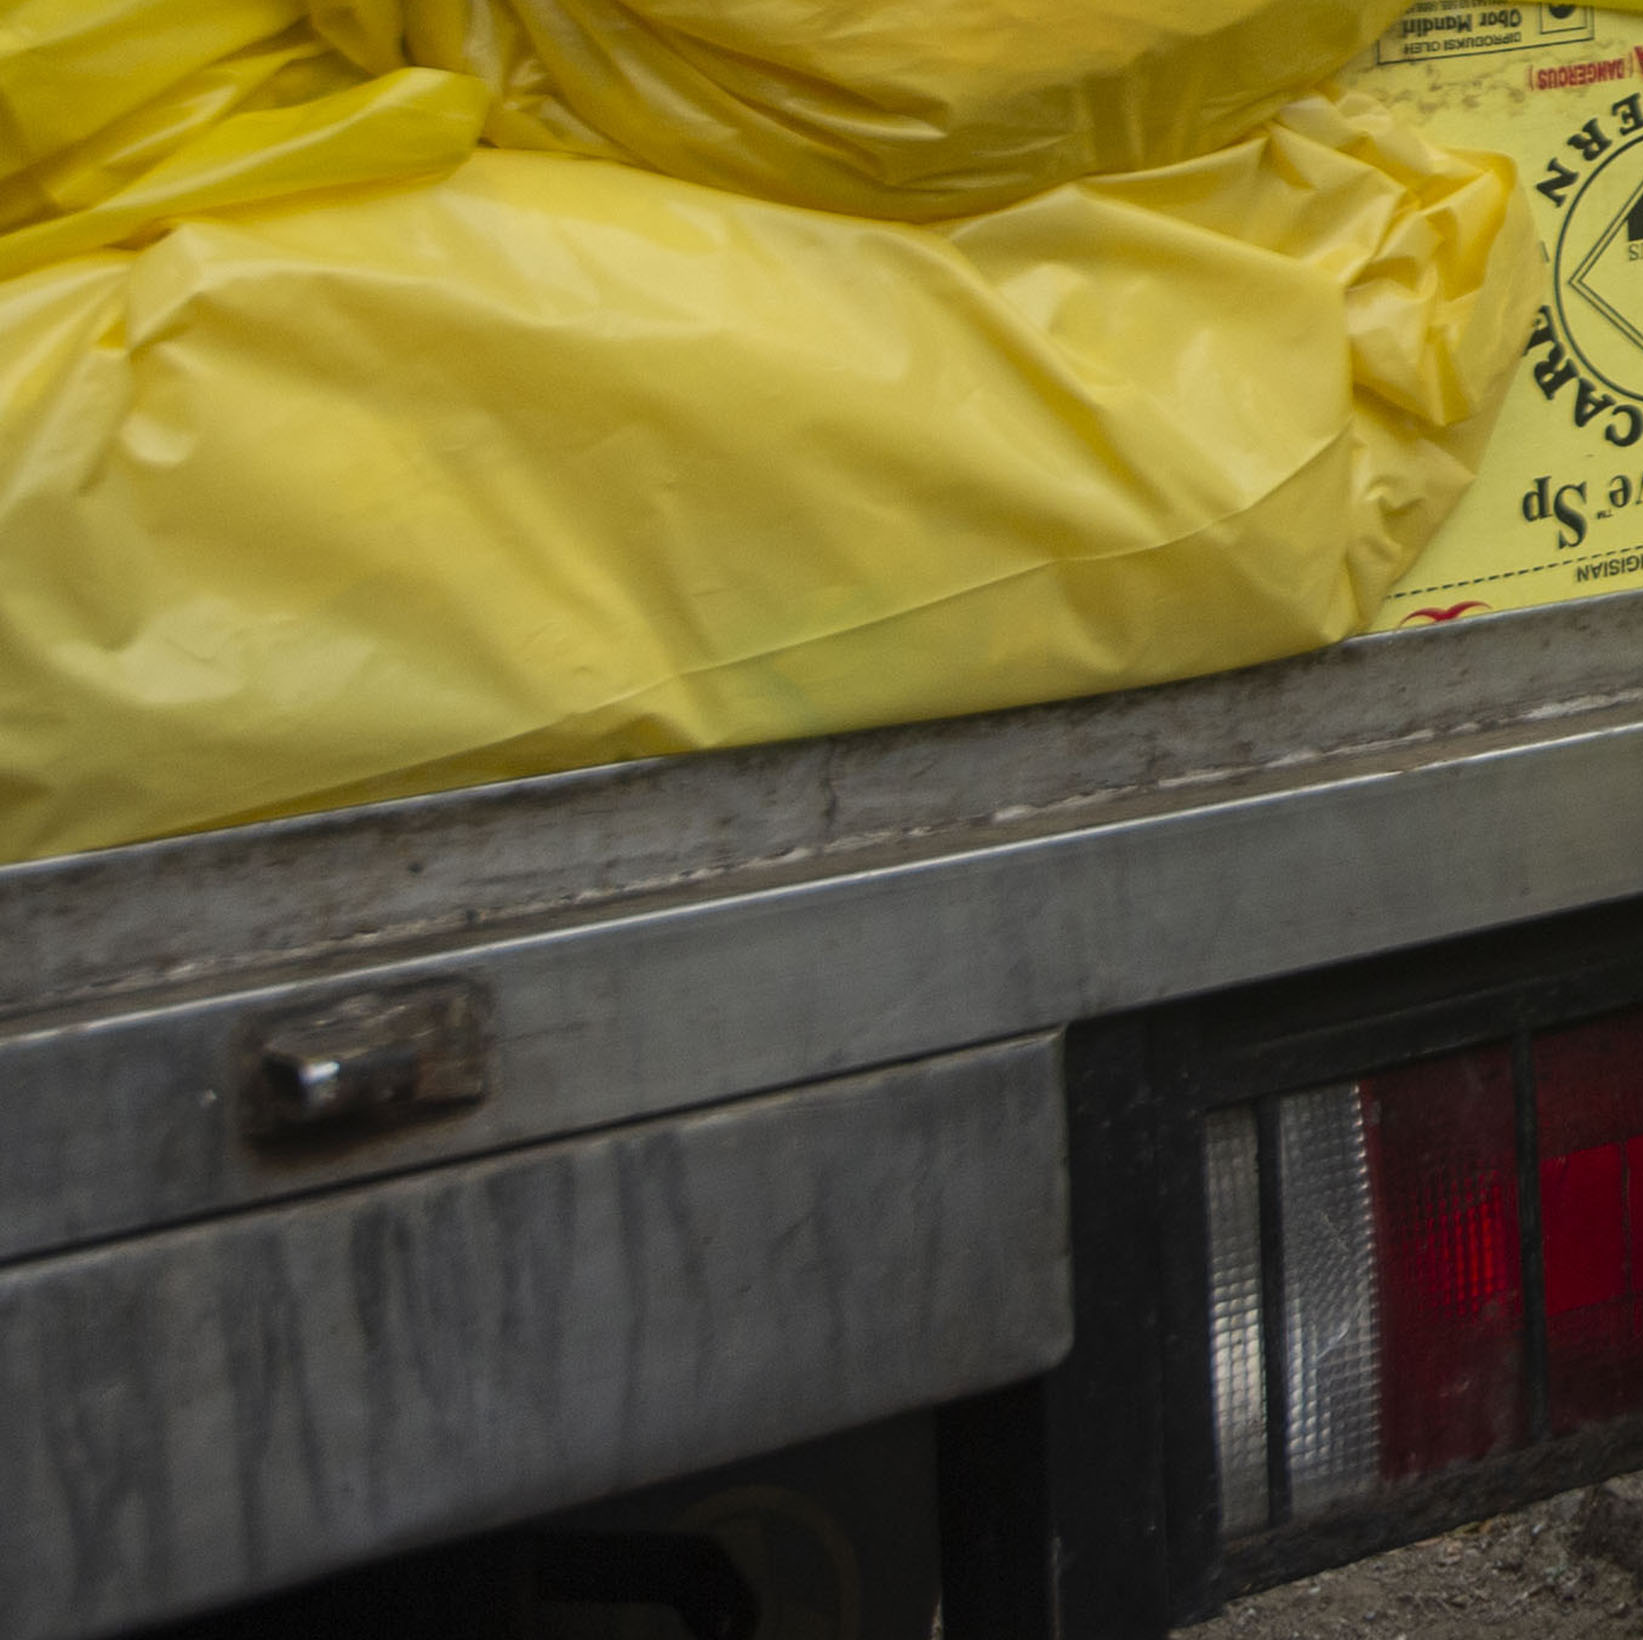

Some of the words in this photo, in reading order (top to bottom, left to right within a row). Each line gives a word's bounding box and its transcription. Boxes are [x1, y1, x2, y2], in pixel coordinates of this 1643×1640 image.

[1479, 9, 1522, 28] Obor
[1403, 39, 1440, 55] OLEH
[1444, 32, 1521, 51] DIPRODUKSI
[1521, 475, 1588, 550] Sp
